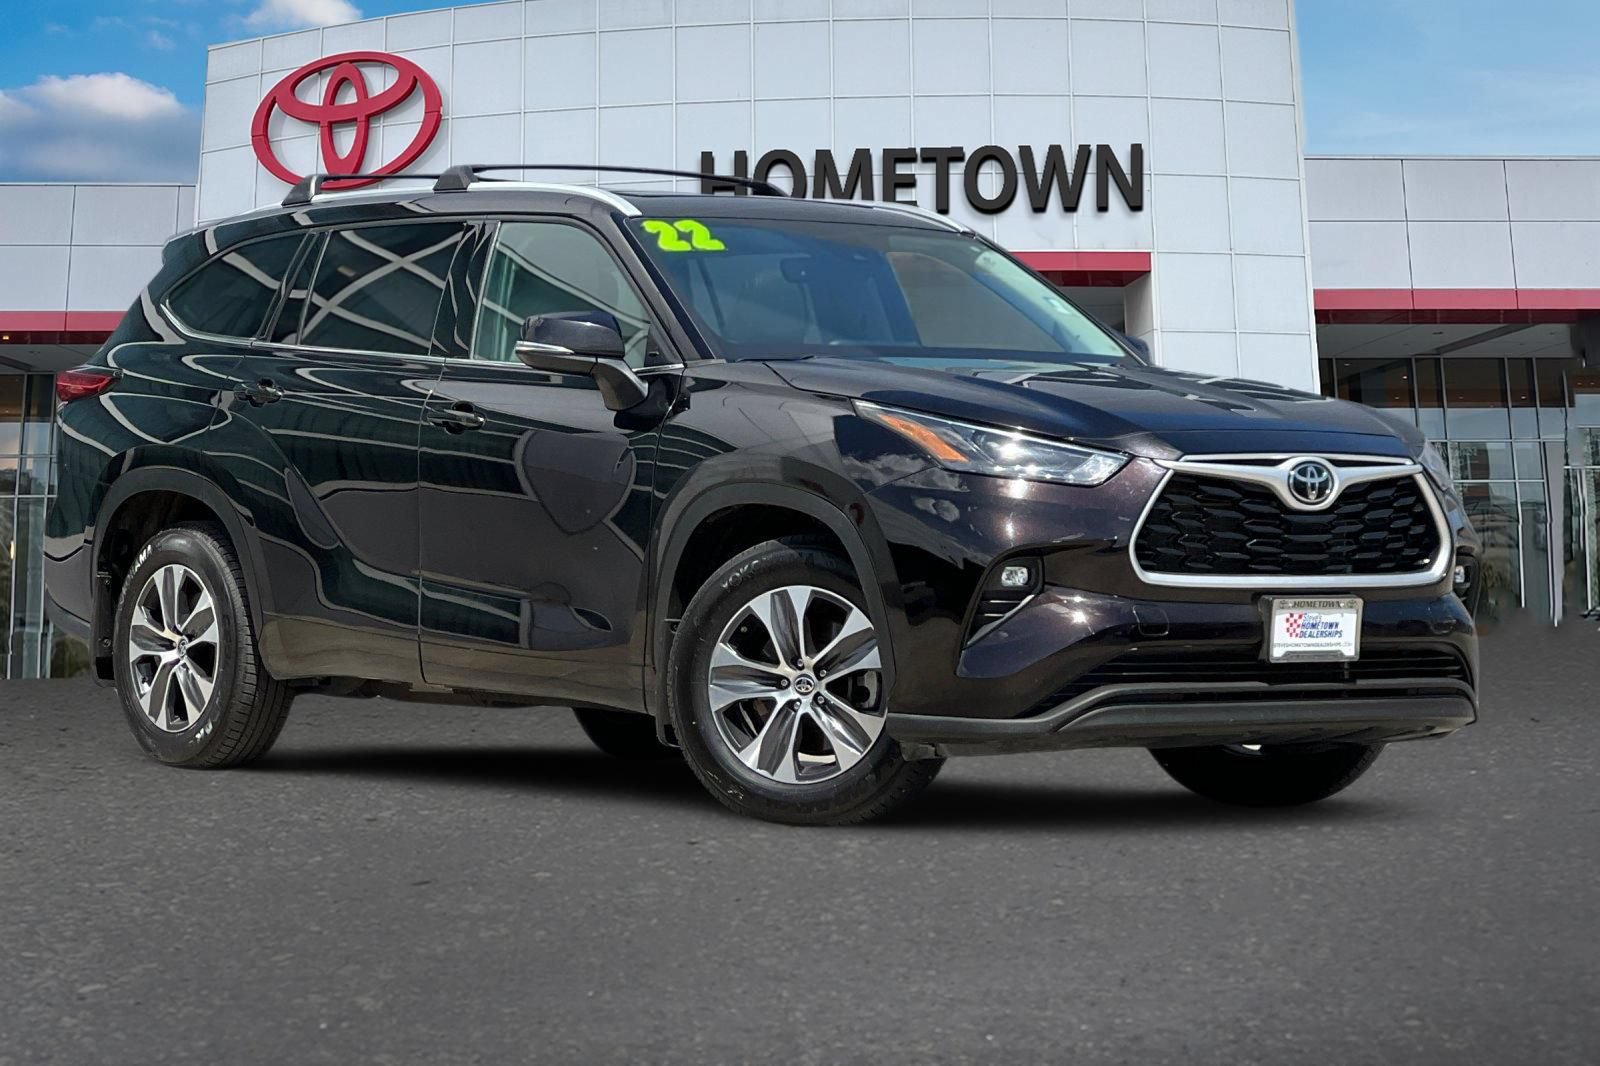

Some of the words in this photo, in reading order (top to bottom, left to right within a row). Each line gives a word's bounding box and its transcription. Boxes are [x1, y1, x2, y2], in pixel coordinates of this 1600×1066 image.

[700, 143, 1144, 214] HOMETOWN
[640, 219, 726, 252] 22
[1299, 630, 1343, 638] DEALERSHIPS
